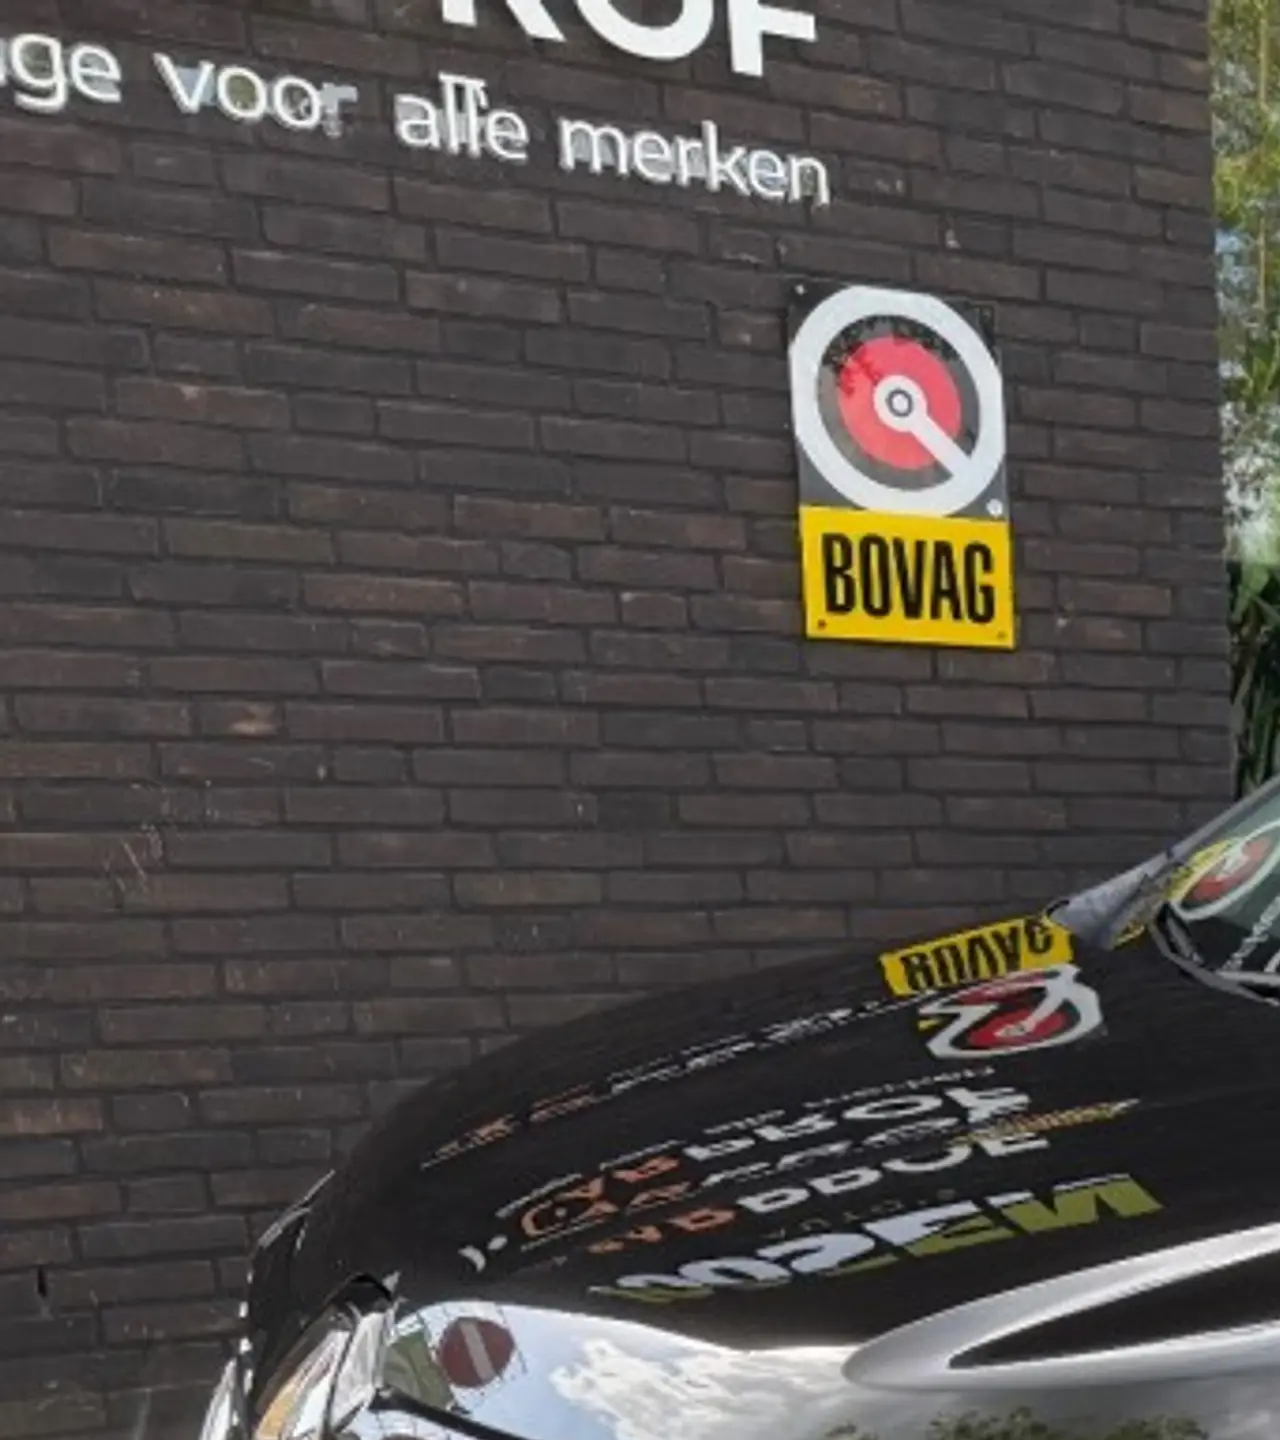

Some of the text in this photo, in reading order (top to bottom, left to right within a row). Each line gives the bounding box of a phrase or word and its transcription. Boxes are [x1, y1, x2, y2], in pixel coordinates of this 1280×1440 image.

[0, 32, 831, 207] ge voor alle merken
[820, 532, 996, 624] BOVAG
